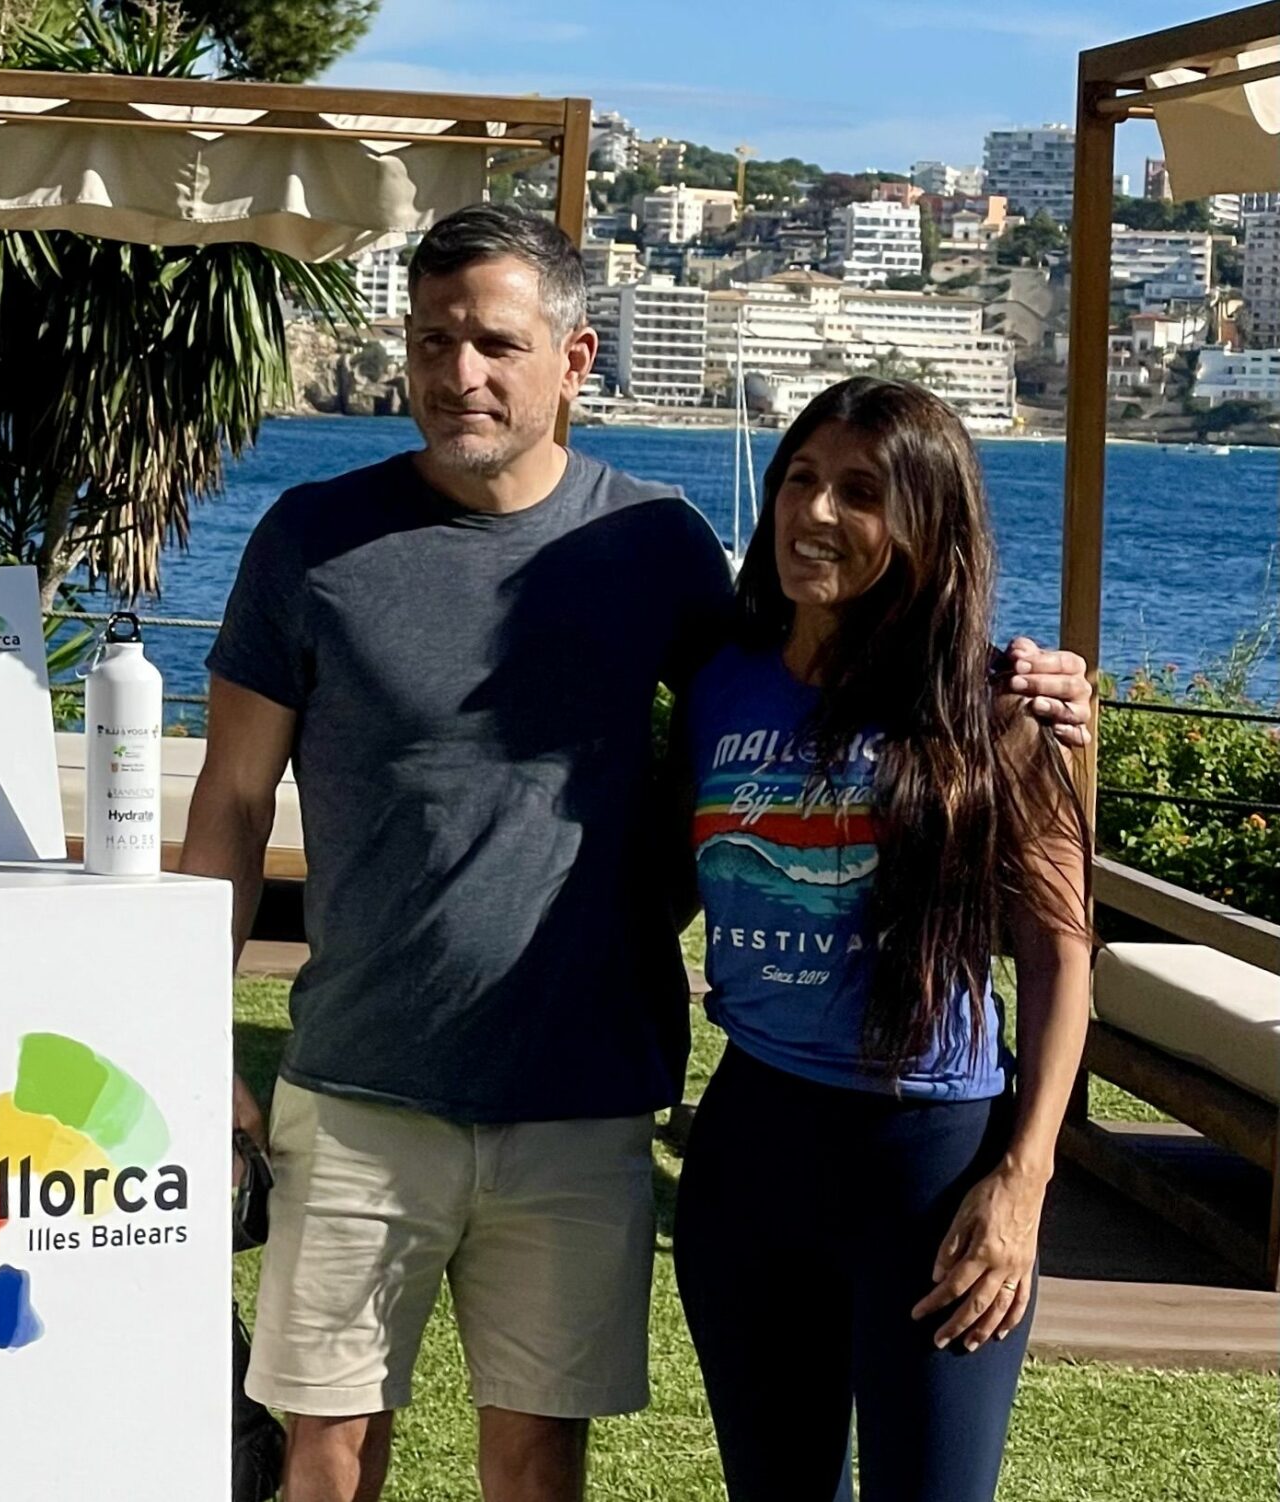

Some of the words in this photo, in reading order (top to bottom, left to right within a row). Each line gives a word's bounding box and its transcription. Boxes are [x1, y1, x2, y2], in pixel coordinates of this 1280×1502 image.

[108, 809, 154, 823] Hydrate
[761, 964, 795, 984] Since
[796, 969, 831, 986] 2019
[28, 1228, 80, 1252] Illes
[91, 1223, 188, 1249] Balears
